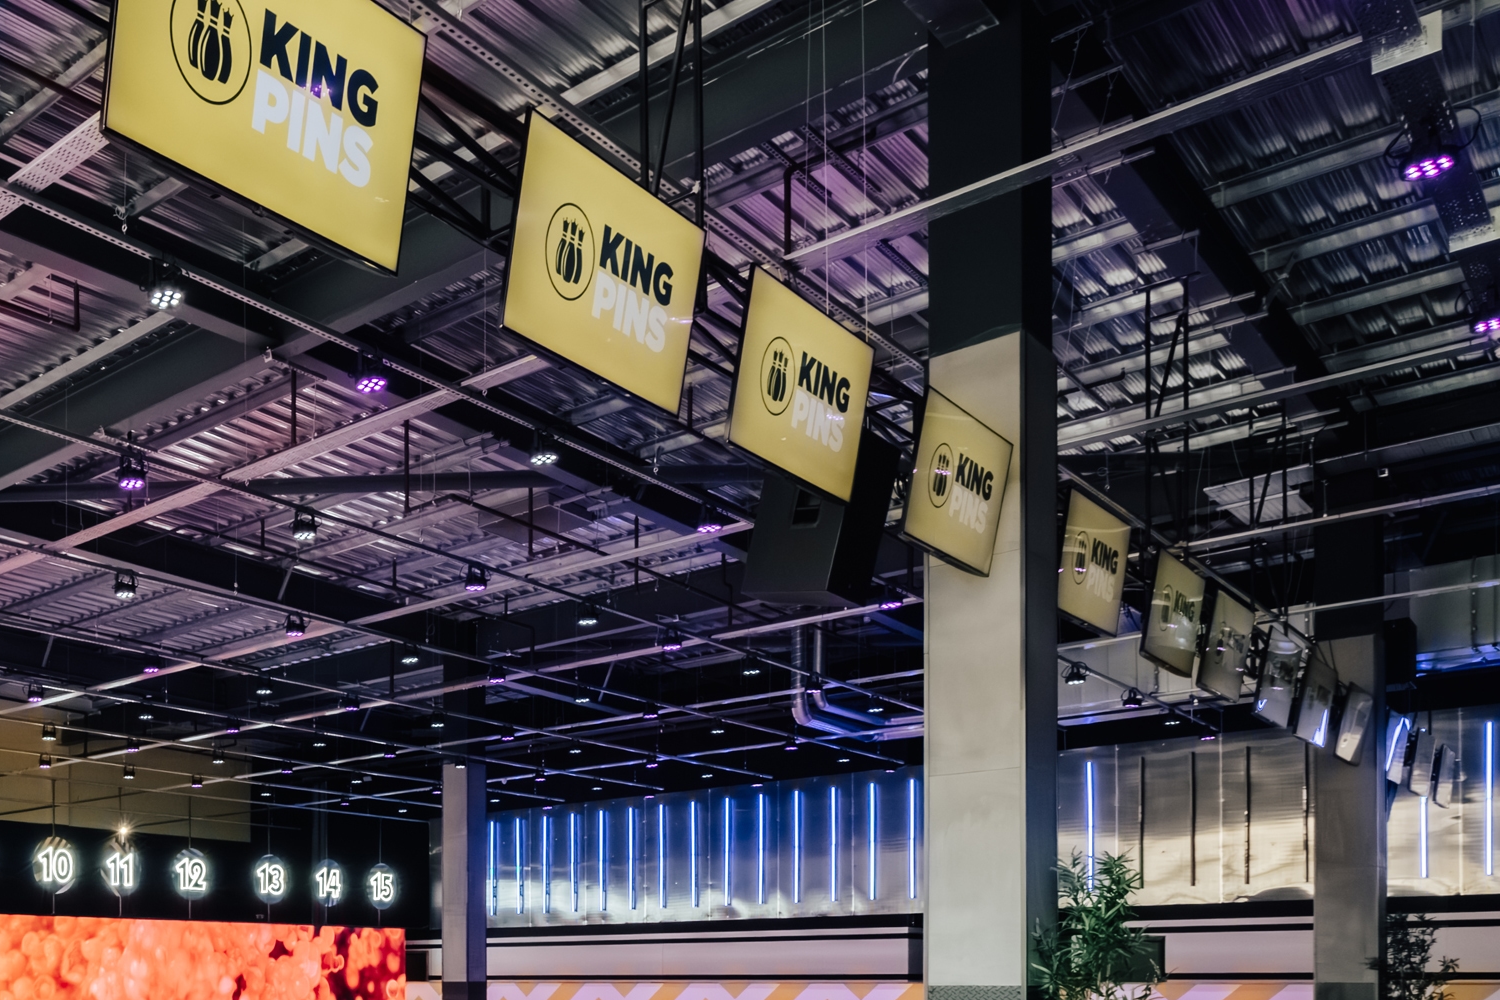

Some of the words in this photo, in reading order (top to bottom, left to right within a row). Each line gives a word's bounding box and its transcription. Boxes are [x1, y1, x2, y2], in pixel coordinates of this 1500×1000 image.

[259, 7, 379, 127] KING
[251, 68, 376, 188] PINS
[599, 224, 674, 307] KING
[591, 269, 668, 353] PINS
[798, 351, 851, 413] KING
[791, 388, 846, 453] PINS
[955, 453, 994, 501] KING
[949, 482, 989, 534] PINS
[1090, 537, 1119, 575] KING
[38, 846, 74, 883] 10
[106, 852, 134, 887] 11
[176, 858, 207, 892] 12
[256, 863, 285, 897] 13
[315, 867, 341, 899] 14
[370, 872, 394, 902] 15
